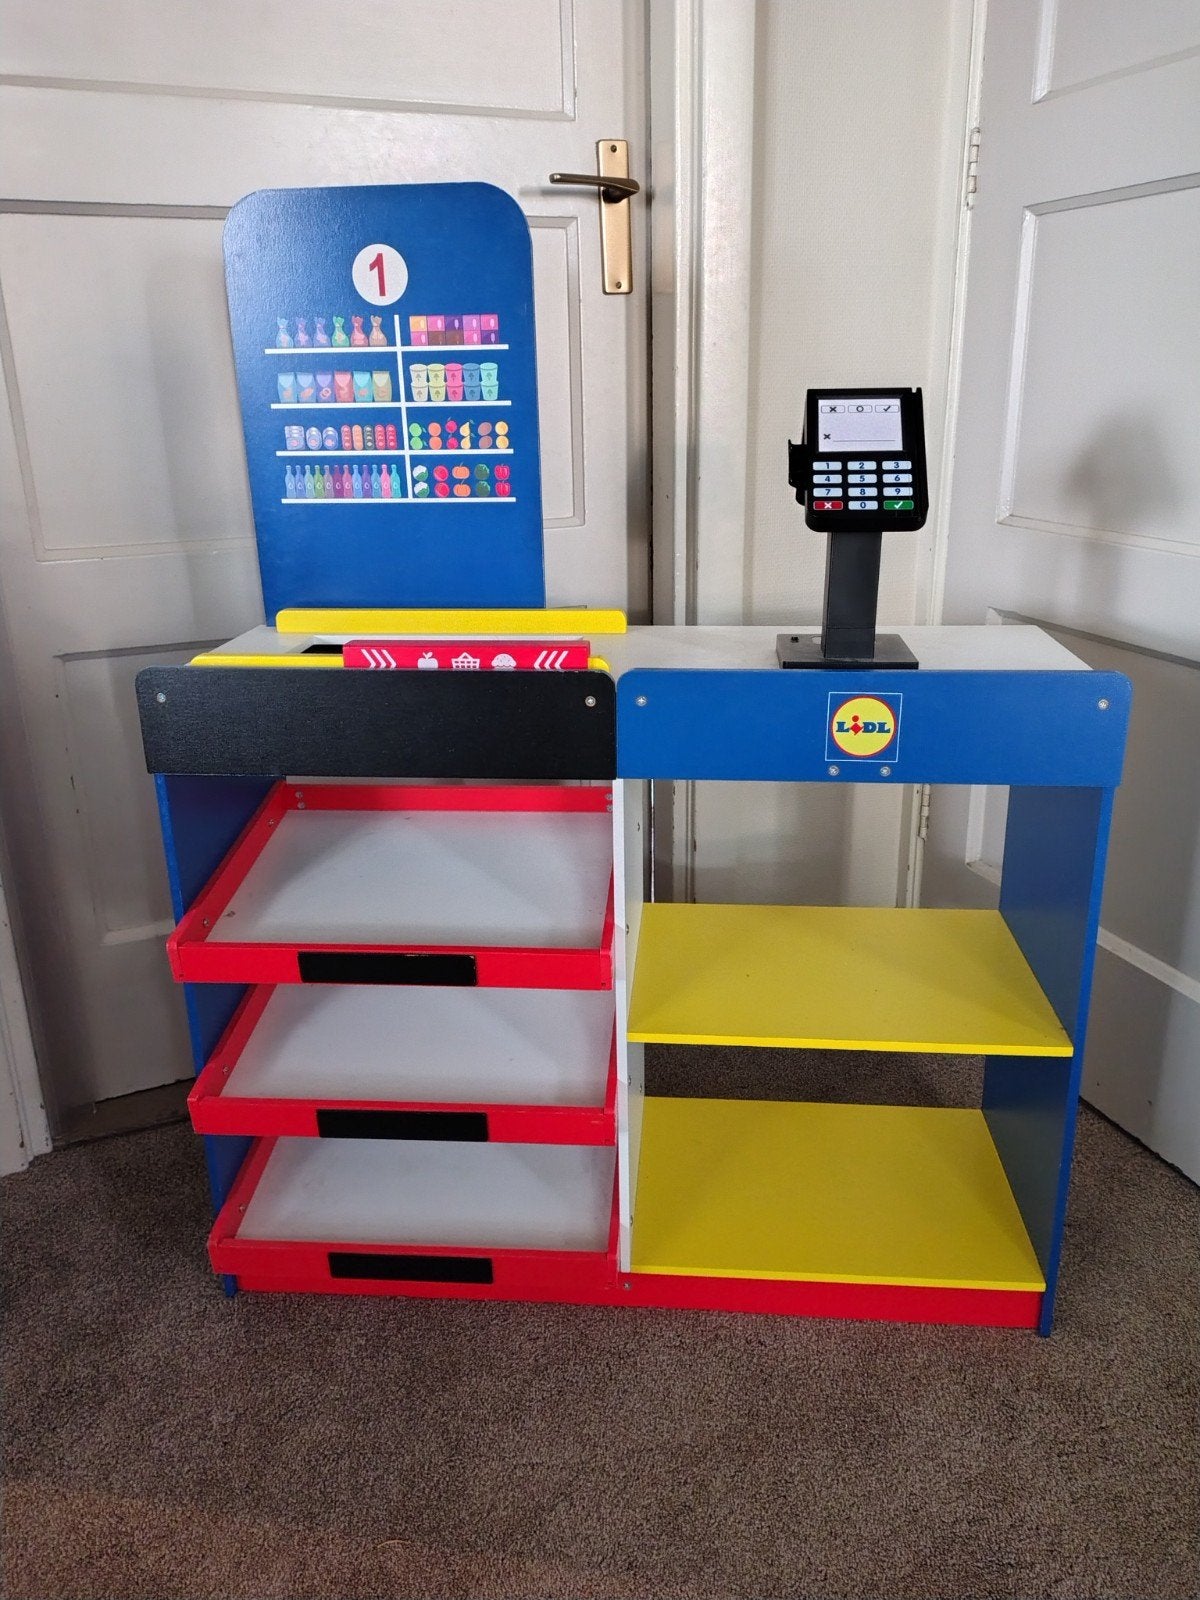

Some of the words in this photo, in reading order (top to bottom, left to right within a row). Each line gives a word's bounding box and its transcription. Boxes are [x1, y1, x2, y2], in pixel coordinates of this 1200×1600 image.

[369, 253, 386, 296] 1
[825, 462, 830, 470] 1
[858, 462, 865, 470] 2
[893, 461, 900, 469] 3
[824, 475, 831, 483] 4
[894, 474, 901, 482] 6
[859, 488, 866, 496] 8
[895, 487, 902, 495] 9
[859, 501, 867, 510] 0
